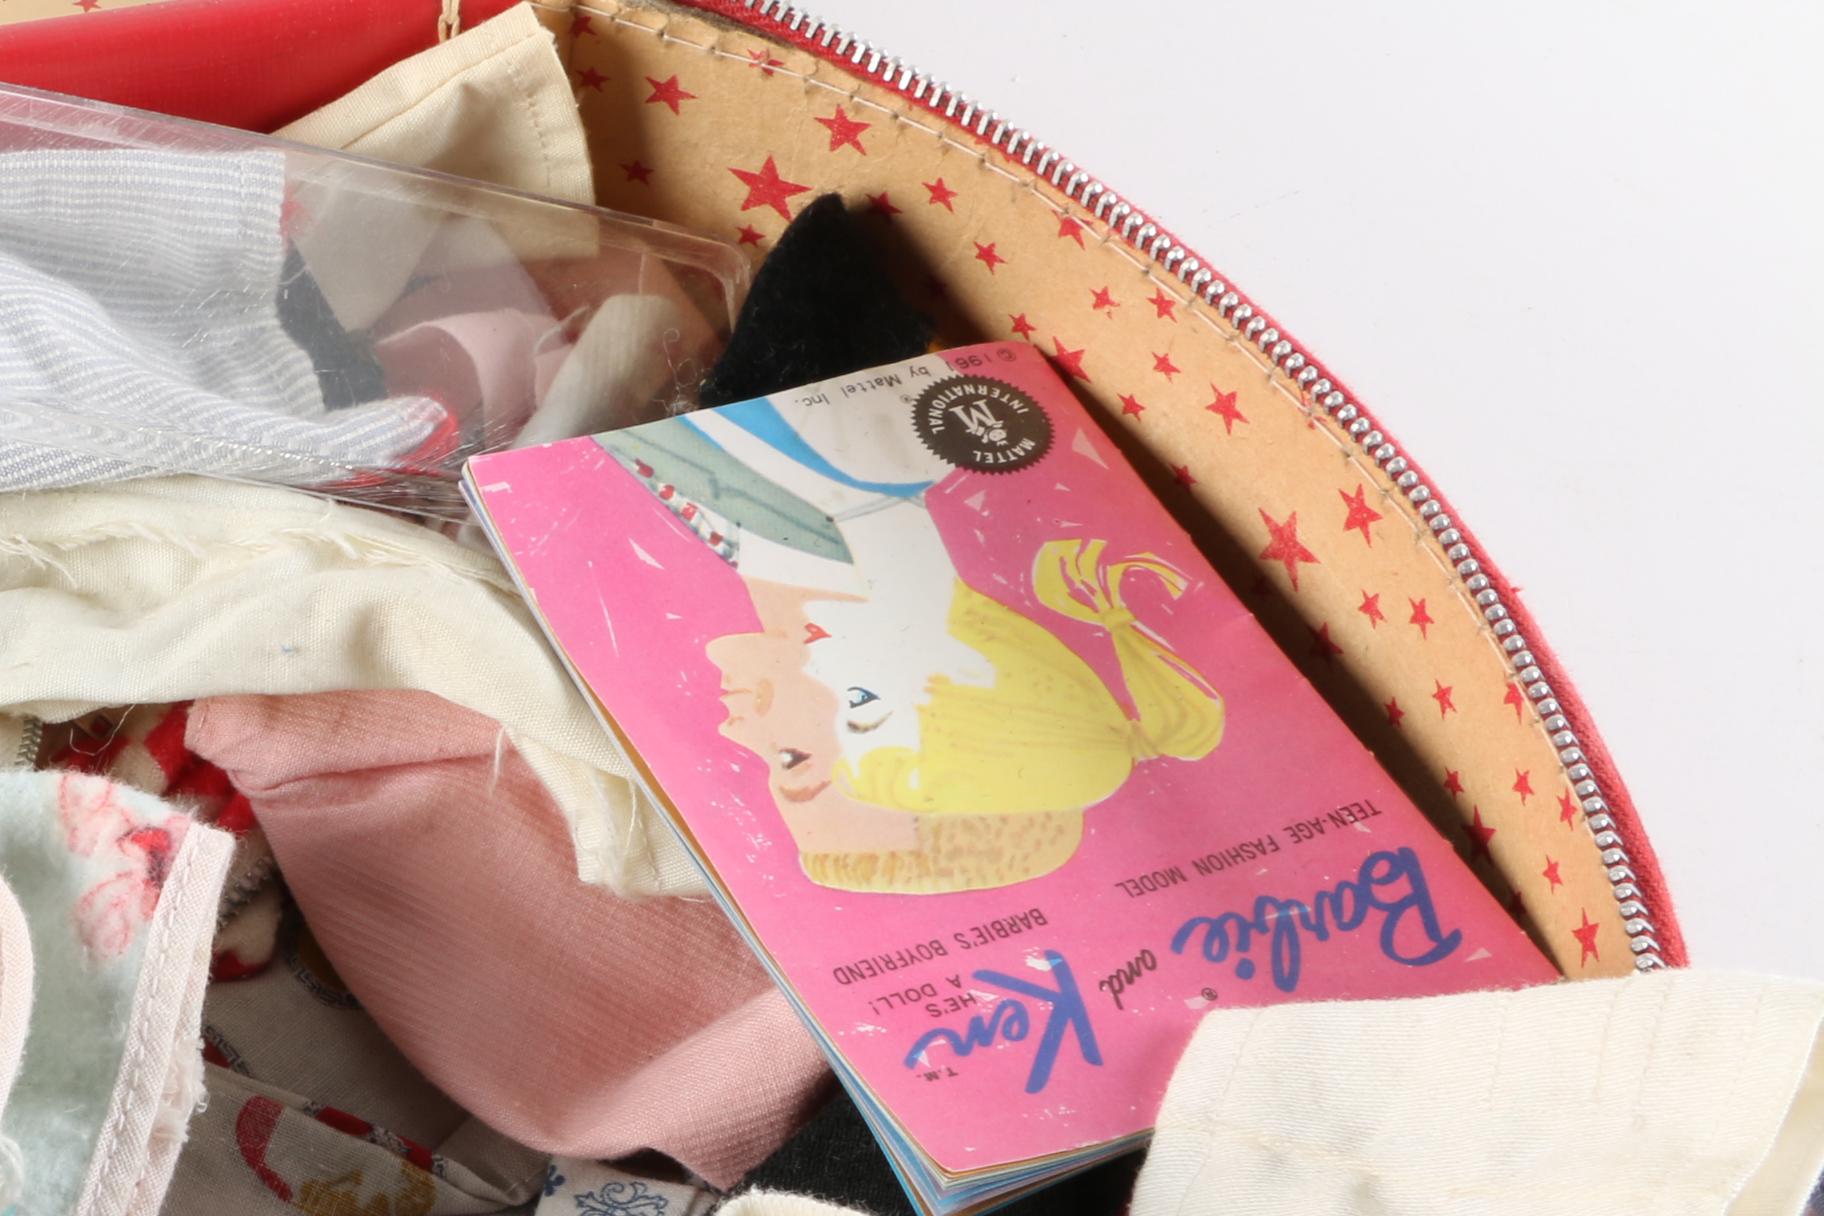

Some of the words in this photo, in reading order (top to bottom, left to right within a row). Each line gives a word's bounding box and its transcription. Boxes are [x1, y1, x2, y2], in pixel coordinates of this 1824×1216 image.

[840, 373, 903, 398] Mattel
[908, 365, 930, 379] by
[794, 392, 831, 407] Inc.
[927, 383, 1030, 435] INTERNATIONAL
[973, 437, 1036, 465] MATTEL
[1283, 799, 1383, 844] TEEN-AGE
[1191, 833, 1281, 877] FASHION
[1114, 865, 1188, 898] MODEL
[953, 907, 1049, 950] BARBIE'S
[1170, 846, 1463, 993] Barbie
[832, 938, 949, 986] BOYFRIEND
[1098, 948, 1158, 1011] and
[867, 983, 938, 1015] DOLL!
[945, 974, 963, 989] A
[903, 949, 1104, 1094] Ken
[926, 992, 977, 1018] HE'S
